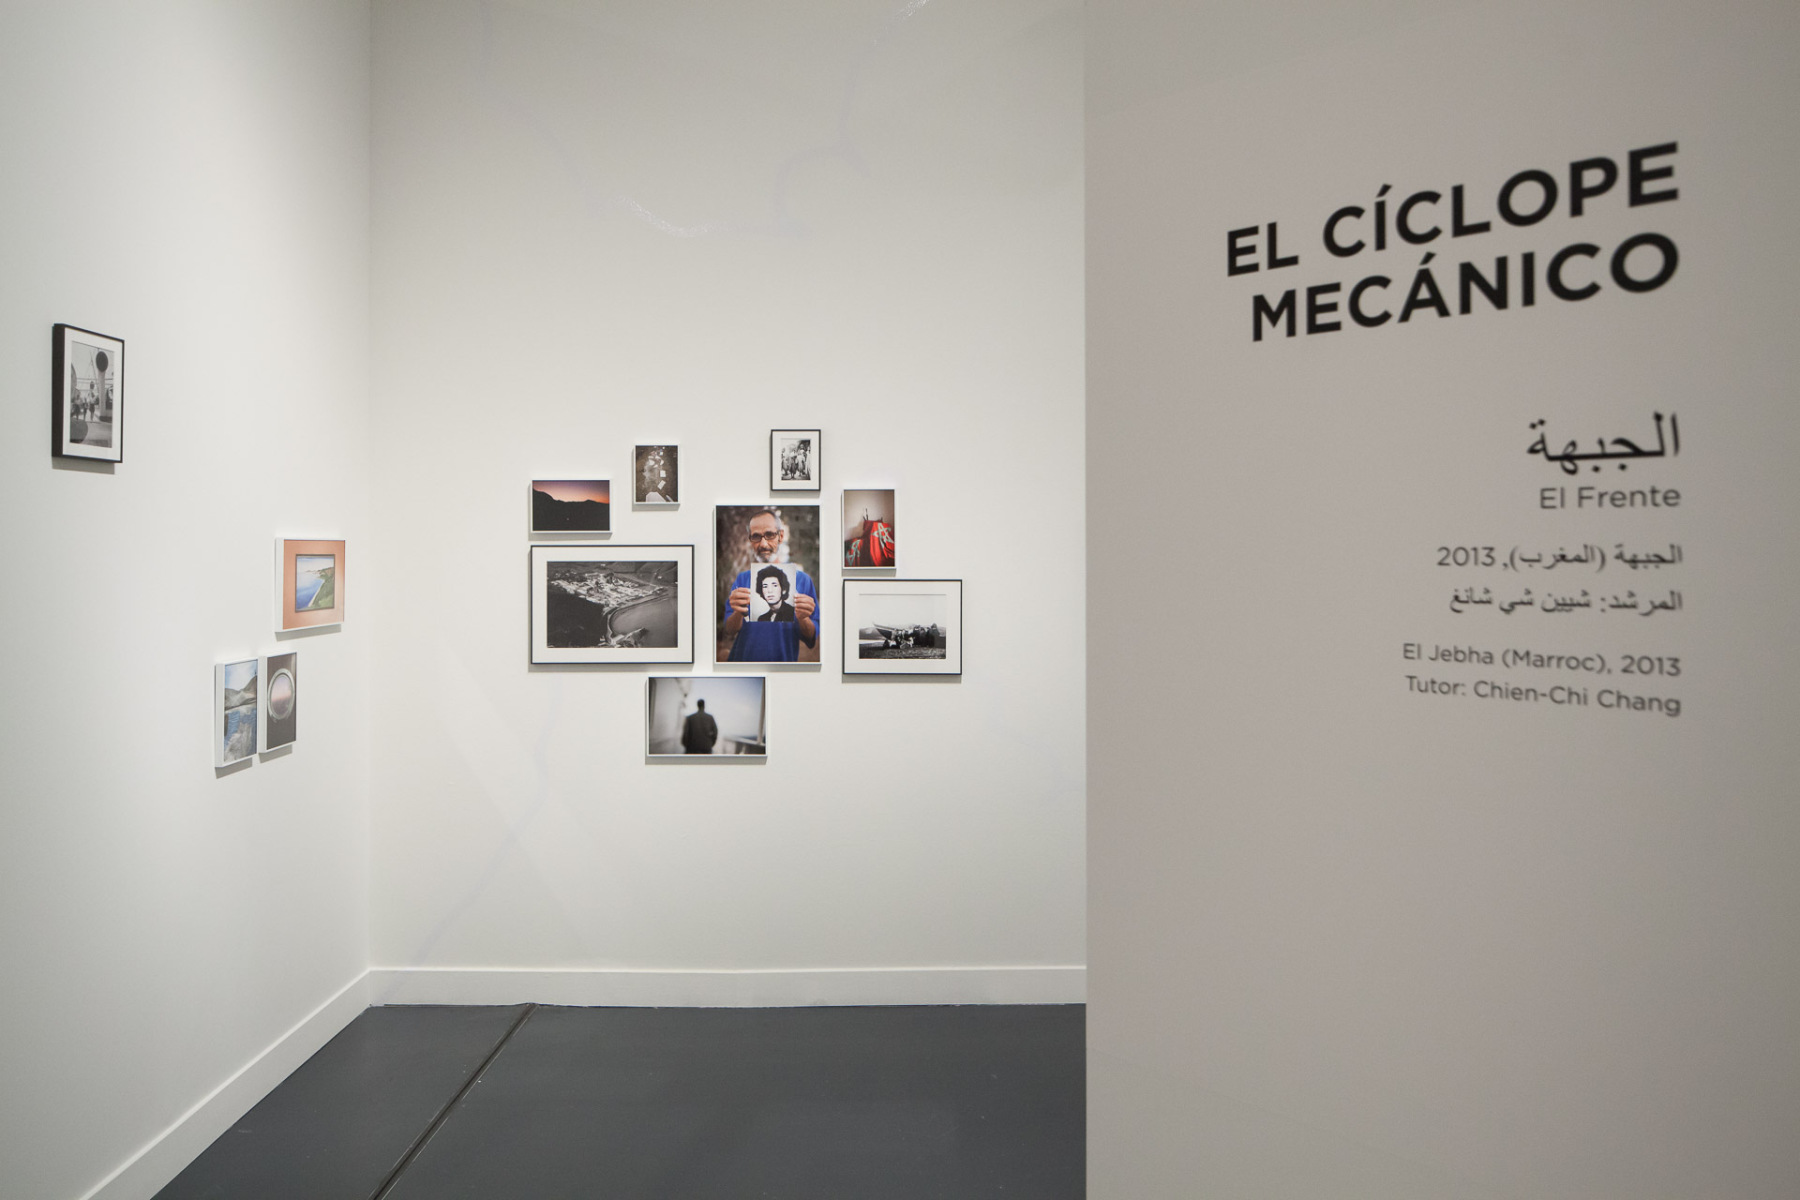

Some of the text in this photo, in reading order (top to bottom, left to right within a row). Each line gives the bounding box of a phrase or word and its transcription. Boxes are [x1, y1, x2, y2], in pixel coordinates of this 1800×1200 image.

[1226, 140, 1681, 278] EL CÍCLOPE
[1251, 231, 1681, 343] MECÁNICO
[1525, 410, 1681, 477] الجبهة
[1539, 485, 1682, 510] El Frente
[1436, 546, 1497, 568] 2013
[1613, 543, 1683, 571] الجبهة
[1449, 586, 1494, 614] شانغ
[1498, 587, 1535, 616] شي
[1402, 642, 1682, 677] El Jebha (Marroc), 2013
[1404, 674, 1682, 718] Tutor: Chien-Chi Chang
